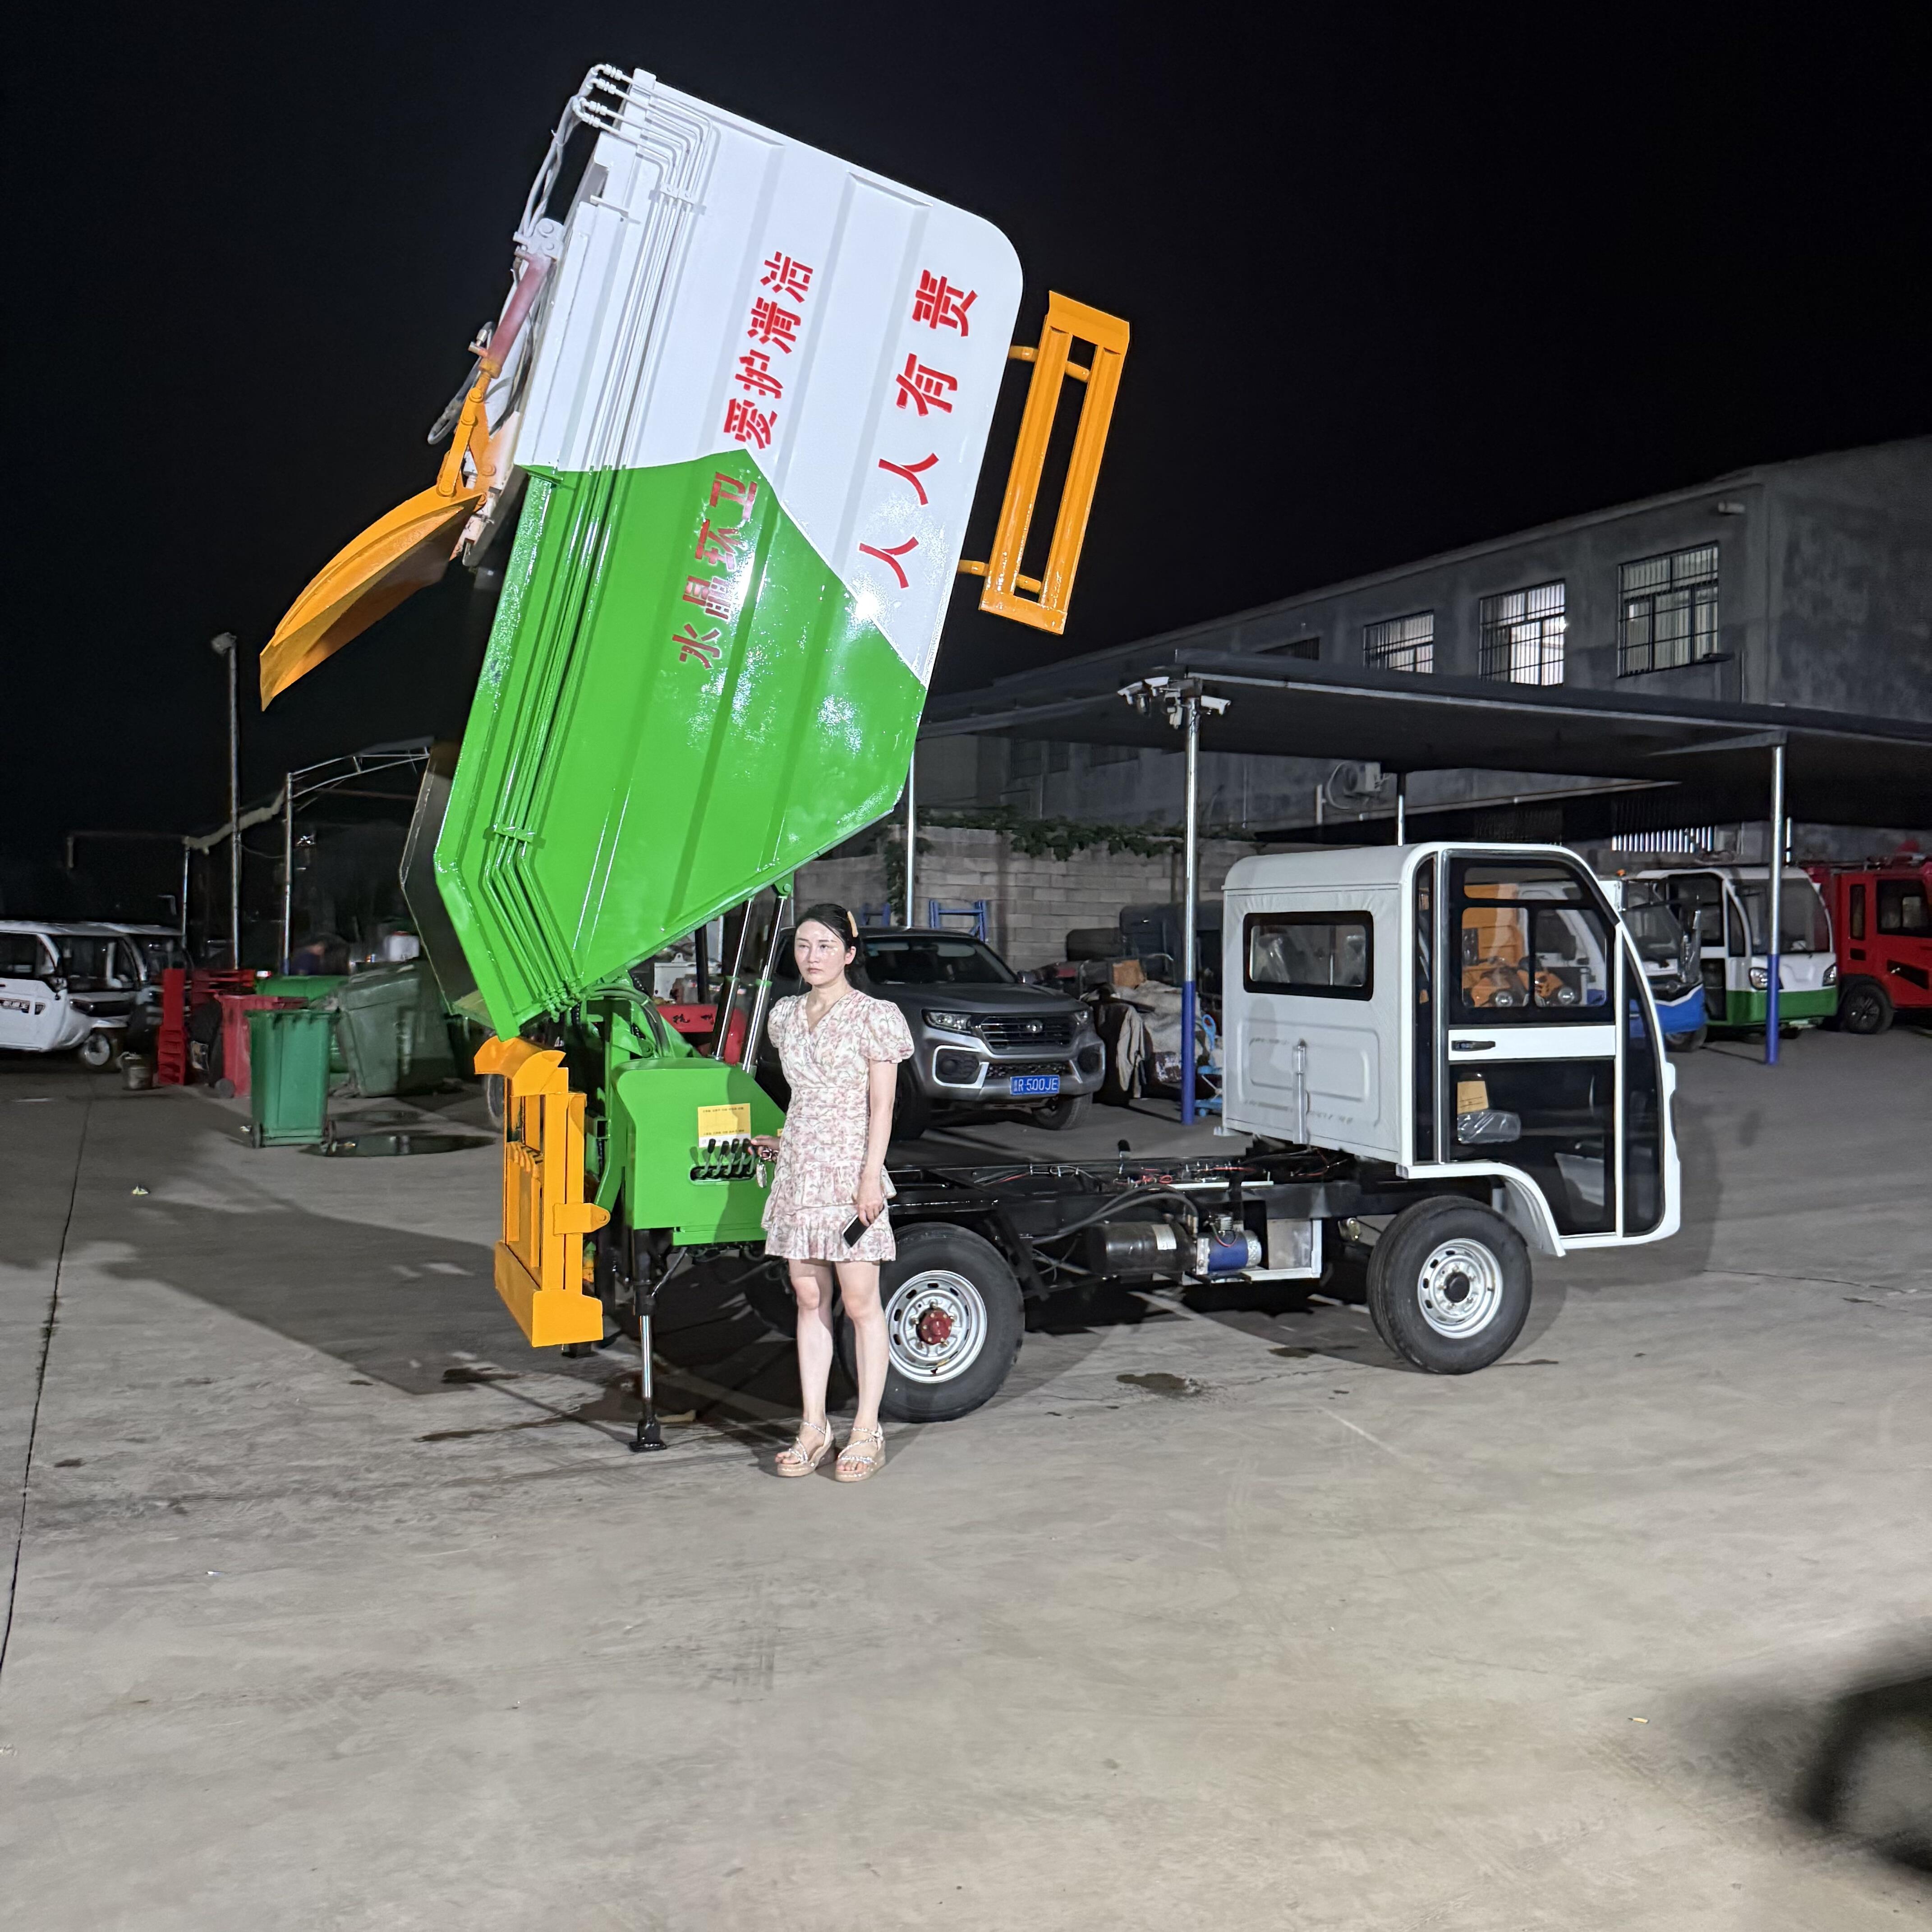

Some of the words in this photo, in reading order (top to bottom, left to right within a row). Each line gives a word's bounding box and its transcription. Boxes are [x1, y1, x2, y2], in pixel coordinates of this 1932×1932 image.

[723, 251, 813, 449] 爱护清洁
[859, 269, 978, 589] 人人有责
[672, 472, 757, 669] 水晶环卫
